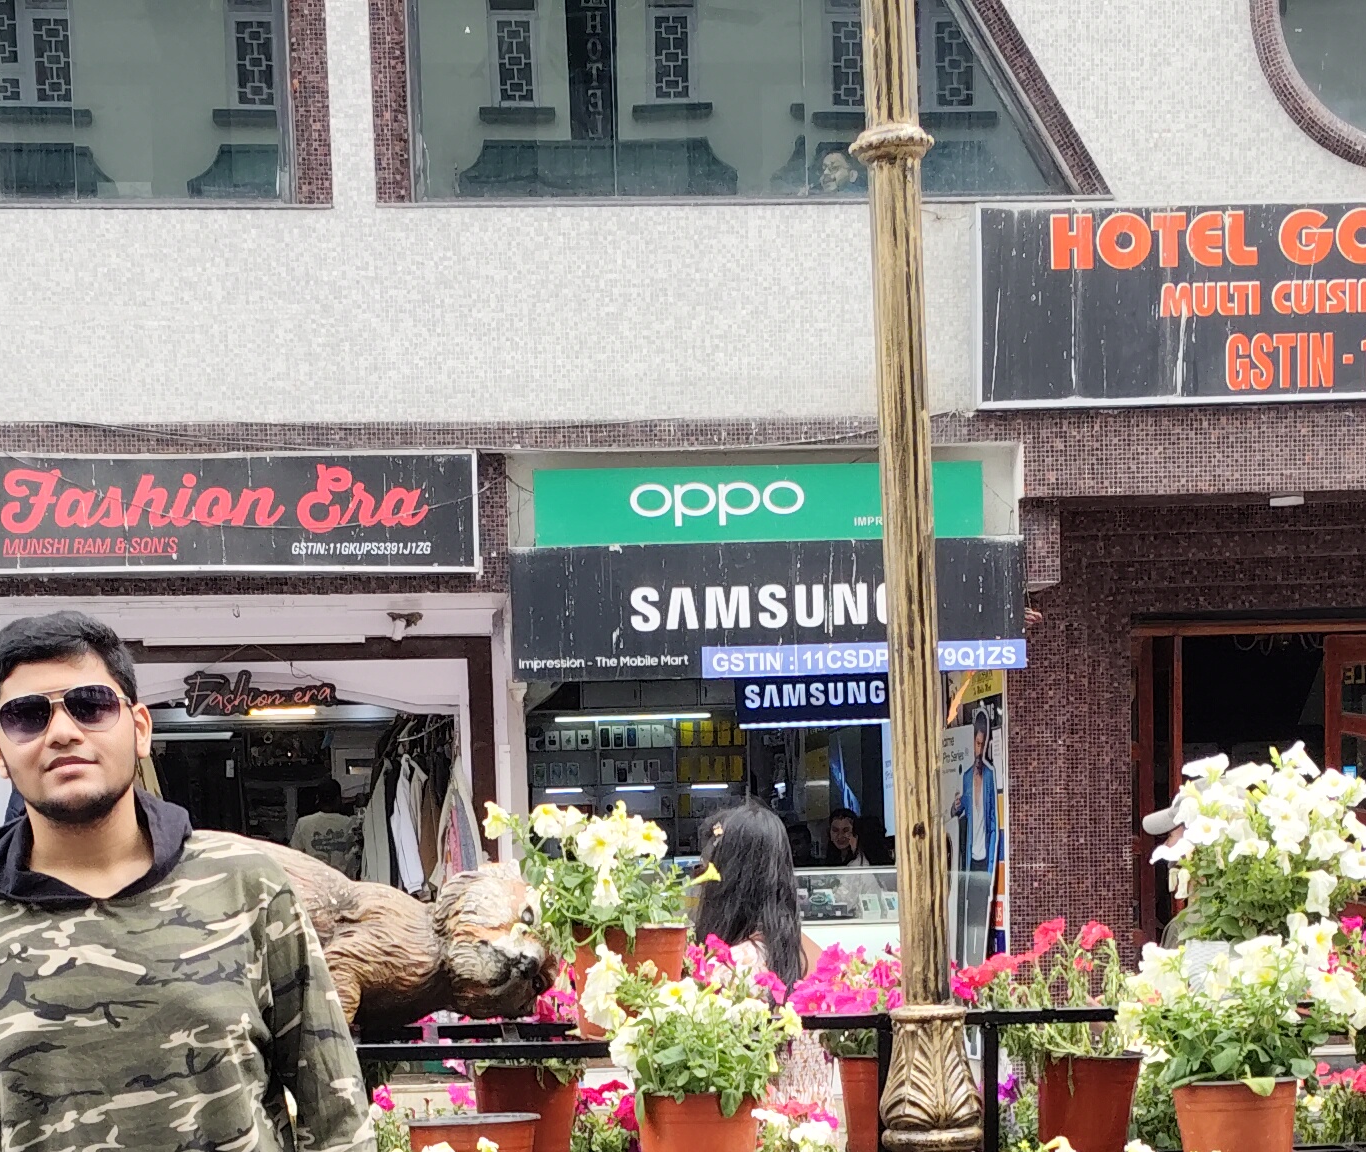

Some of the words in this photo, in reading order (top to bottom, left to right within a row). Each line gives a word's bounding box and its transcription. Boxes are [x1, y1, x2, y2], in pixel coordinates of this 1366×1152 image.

[1051, 212, 1259, 271] HOTEL
[1161, 282, 1262, 317] MULTI
[1226, 331, 1336, 391] GSTIN
[0, 467, 286, 534] Fashion
[296, 463, 429, 534] Era
[853, 515, 884, 528] IMPR
[2, 538, 70, 556] MUNSHI
[71, 538, 112, 555] RAM
[114, 538, 127, 555] &
[128, 537, 178, 556] SON'S
[518, 656, 585, 672] Impression
[595, 656, 618, 668] The
[619, 655, 658, 668] Mobile
[659, 654, 689, 667] Mart
[712, 651, 783, 674] GSTIN
[186, 671, 284, 716] Fashion
[292, 684, 333, 704] era
[744, 680, 886, 709] SAMSUNG
